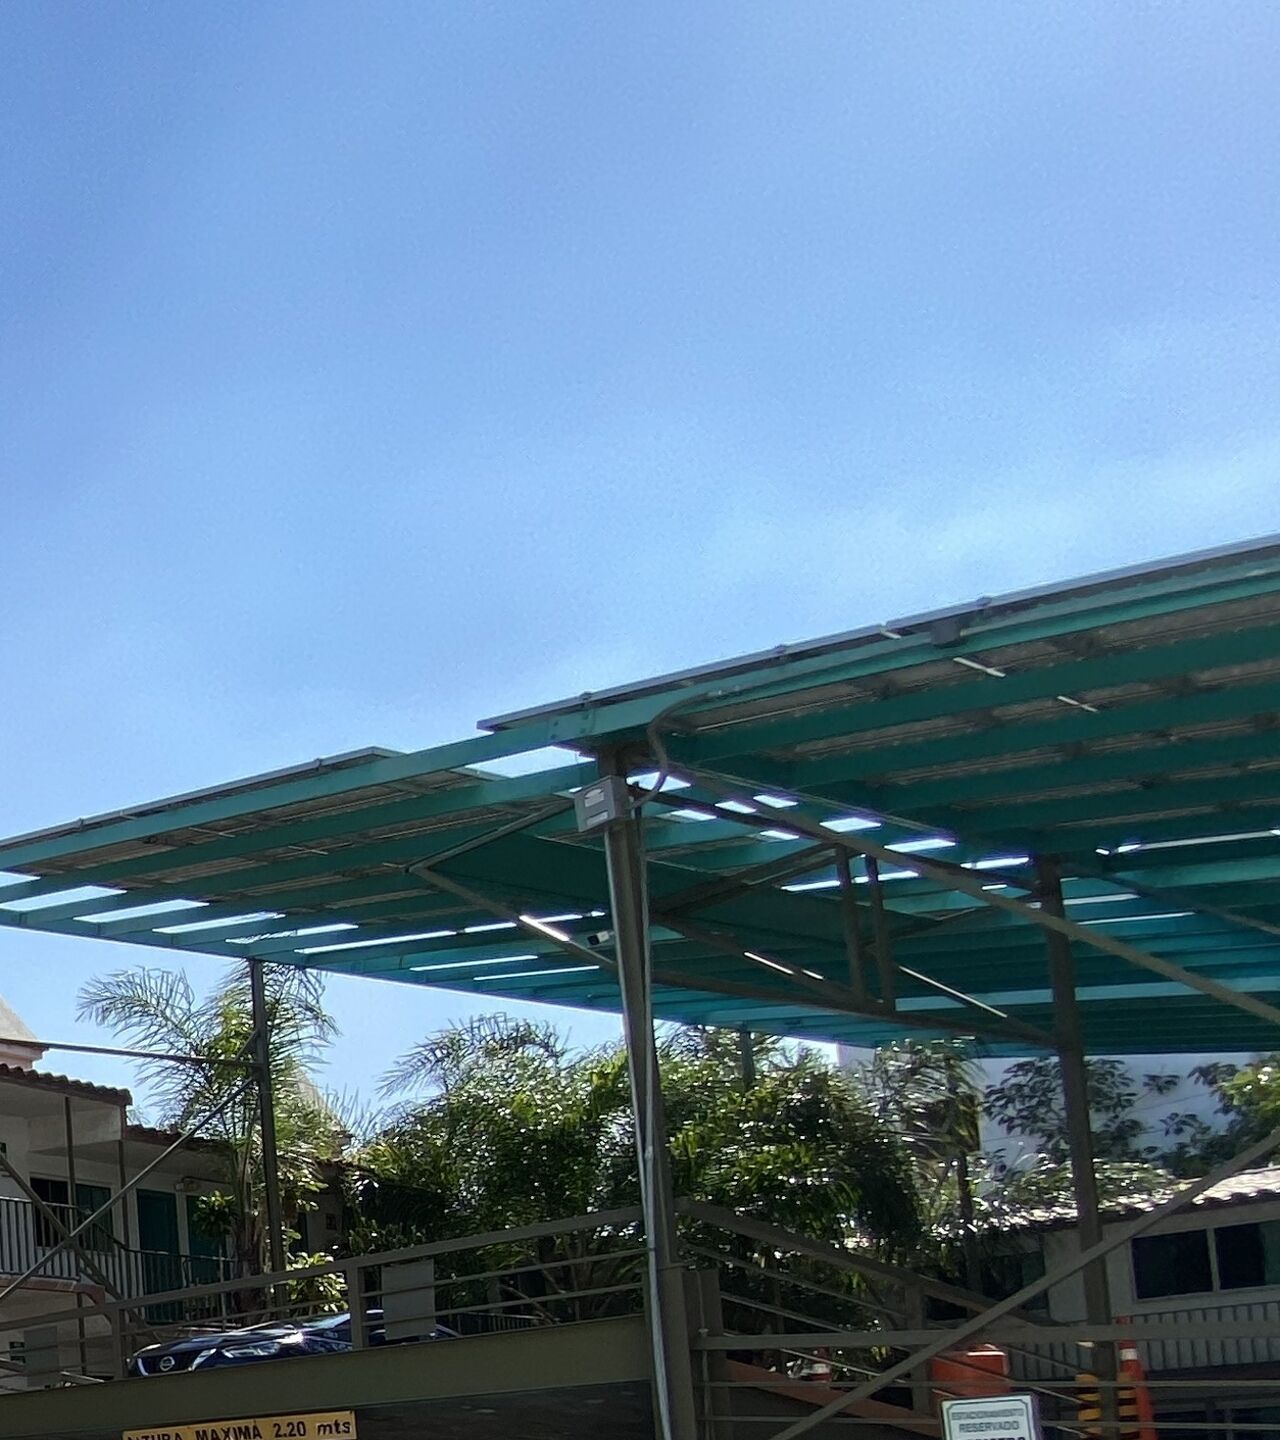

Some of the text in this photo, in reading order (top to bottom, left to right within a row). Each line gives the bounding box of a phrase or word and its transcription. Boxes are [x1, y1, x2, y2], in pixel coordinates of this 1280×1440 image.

[273, 1421, 306, 1438] 2.20
[317, 1418, 352, 1436] mts
[959, 1421, 1020, 1433] RESERVADO
